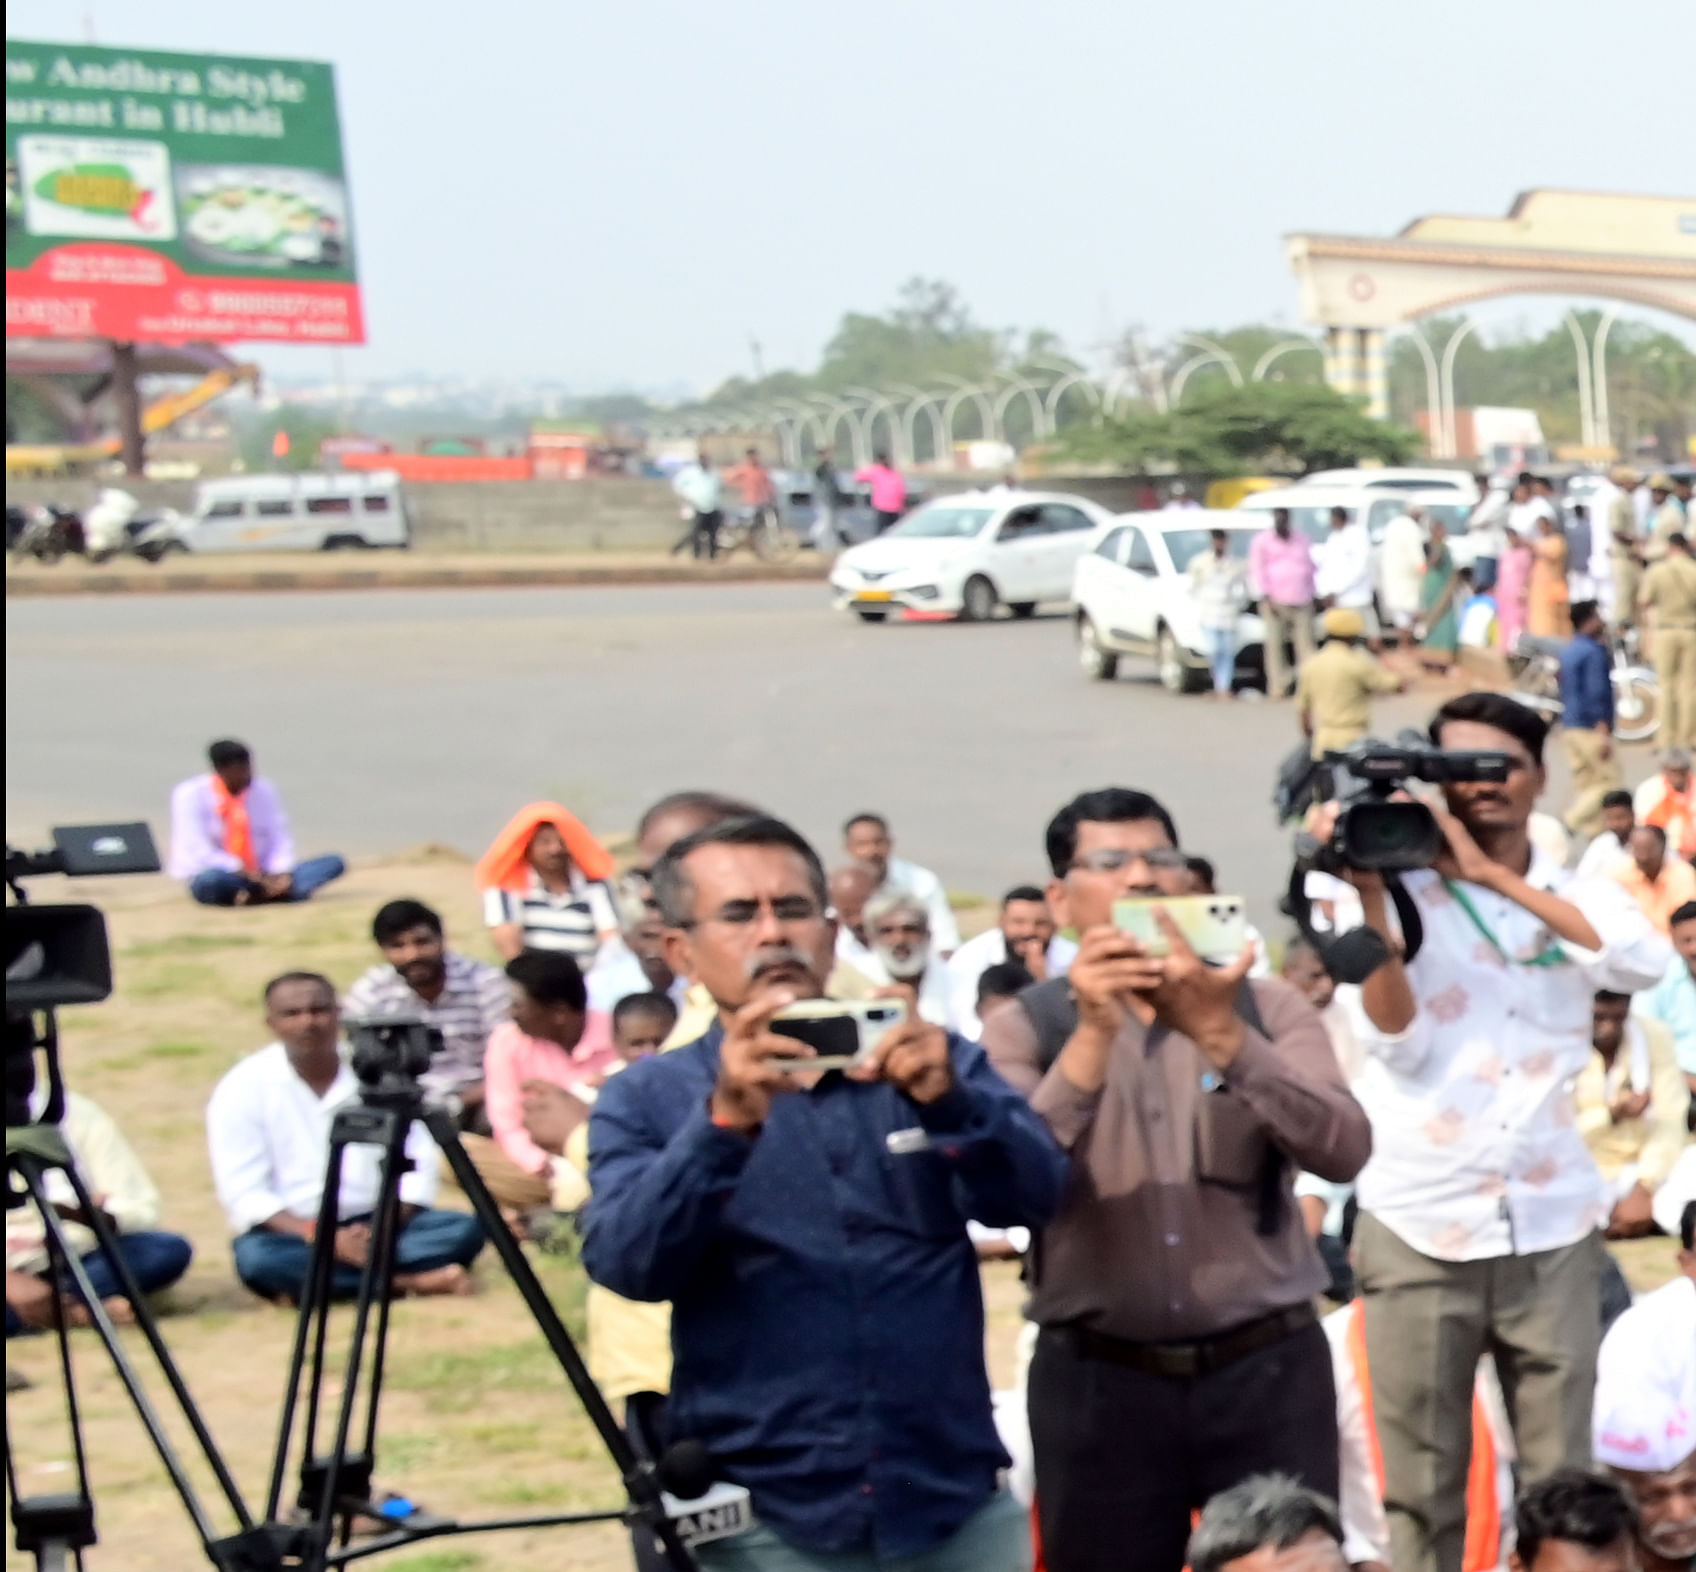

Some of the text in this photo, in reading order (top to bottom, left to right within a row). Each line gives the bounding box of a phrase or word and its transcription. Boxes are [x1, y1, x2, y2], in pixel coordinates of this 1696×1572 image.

[49, 54, 200, 96] Andhra
[207, 66, 307, 106] Style
[123, 97, 164, 130] in
